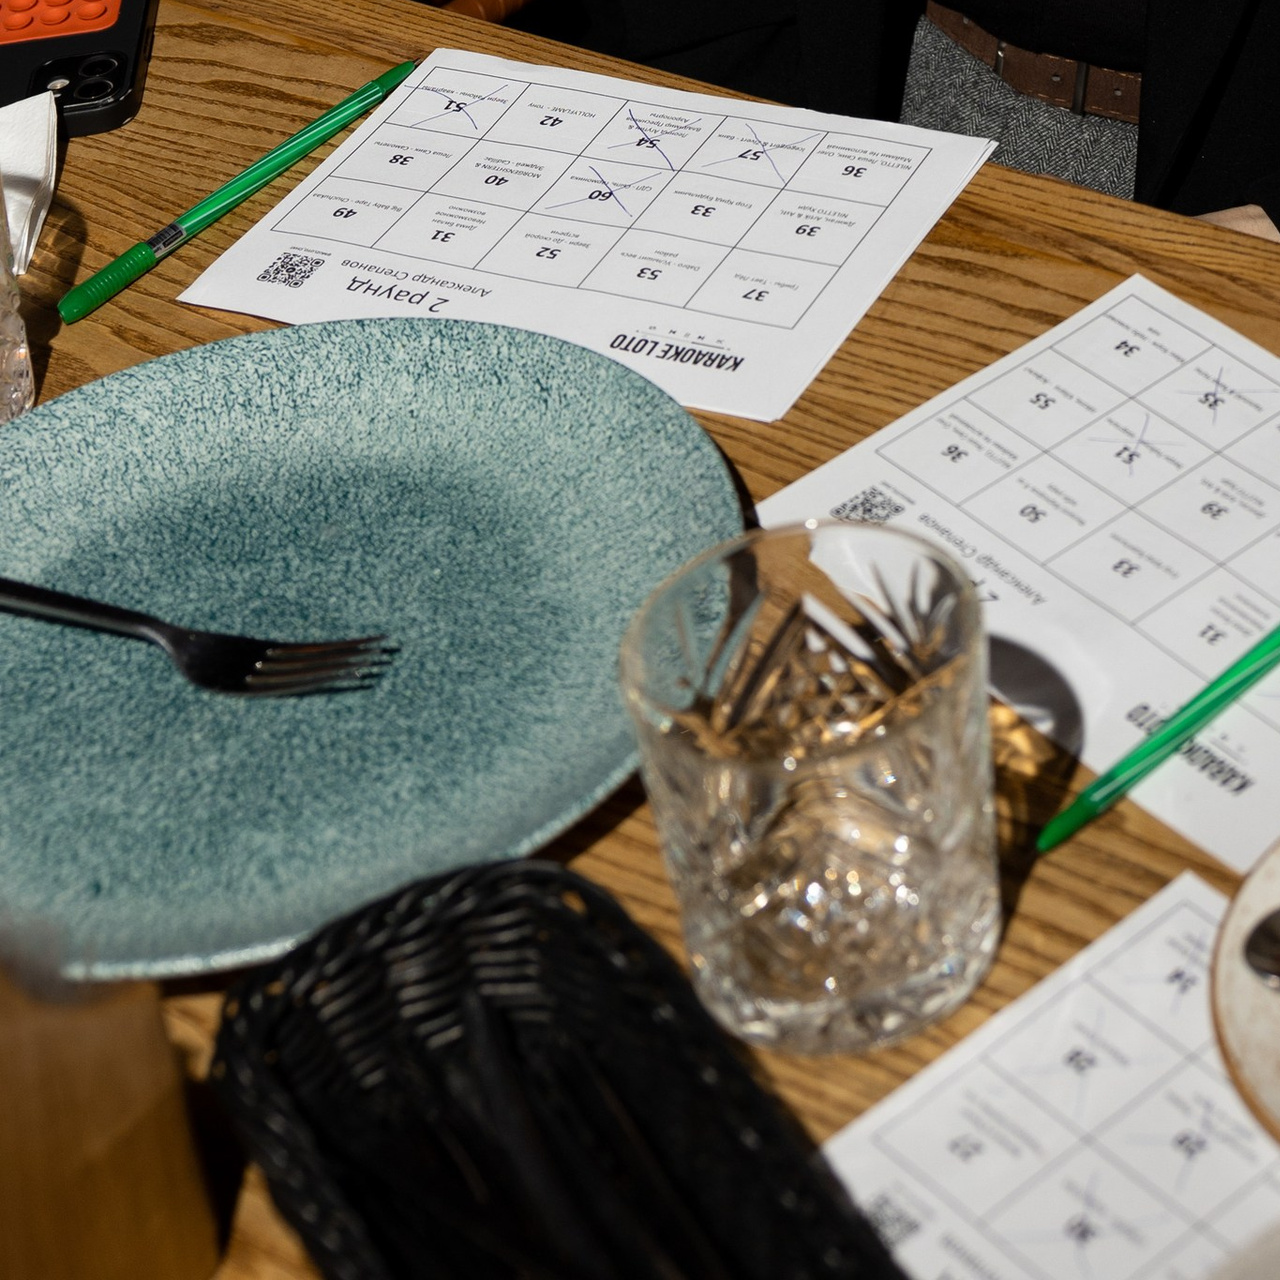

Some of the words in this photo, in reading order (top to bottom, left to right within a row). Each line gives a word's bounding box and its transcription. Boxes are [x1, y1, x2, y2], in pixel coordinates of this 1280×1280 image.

[444, 99, 467, 112] 51
[551, 107, 596, 118] HOLLYFLAME
[539, 115, 563, 127] 42
[374, 141, 409, 151] Самолеты
[636, 135, 660, 149] 54
[737, 149, 765, 161] 57
[826, 144, 868, 154] вспоминай
[389, 154, 414, 165] 38
[484, 157, 511, 165] Cadillac
[482, 164, 541, 179] MORGENSHTERN
[842, 165, 867, 178] 36
[484, 175, 509, 186] 40
[588, 190, 613, 201] 60
[674, 190, 714, 202] Будильник
[714, 197, 734, 205] Крид
[372, 202, 391, 210] Baby
[448, 206, 486, 216] возможно
[691, 205, 716, 217] 33
[735, 201, 753, 209] Егор
[333, 207, 357, 218] 49
[435, 211, 486, 225] Невозможное
[432, 219, 455, 227] Билан
[455, 223, 478, 231] Дима
[431, 230, 455, 242] 31
[524, 233, 552, 241] скорой
[550, 230, 580, 238] встречи
[795, 225, 821, 237] 39
[568, 241, 591, 249] Звери
[536, 247, 561, 259] 52
[654, 250, 679, 258] район
[341, 259, 408, 280] Степанов
[637, 267, 662, 280] 53
[346, 276, 429, 305] раунд
[412, 273, 491, 297] Александр
[742, 289, 769, 301] 37
[428, 297, 449, 313] 2
[610, 334, 659, 356] LOTO
[1115, 340, 1140, 357] 34
[656, 343, 744, 372] KARAOKE
[1030, 393, 1056, 410] 55
[1199, 392, 1225, 410] 35
[942, 445, 968, 462] 36
[1115, 446, 1140, 464] 51
[1019, 505, 1046, 523] 50
[1201, 503, 1228, 520] 39
[918, 514, 978, 558] Степанов
[1112, 559, 1139, 578] 33
[976, 555, 1046, 606] Александр
[1200, 624, 1225, 645] 31
